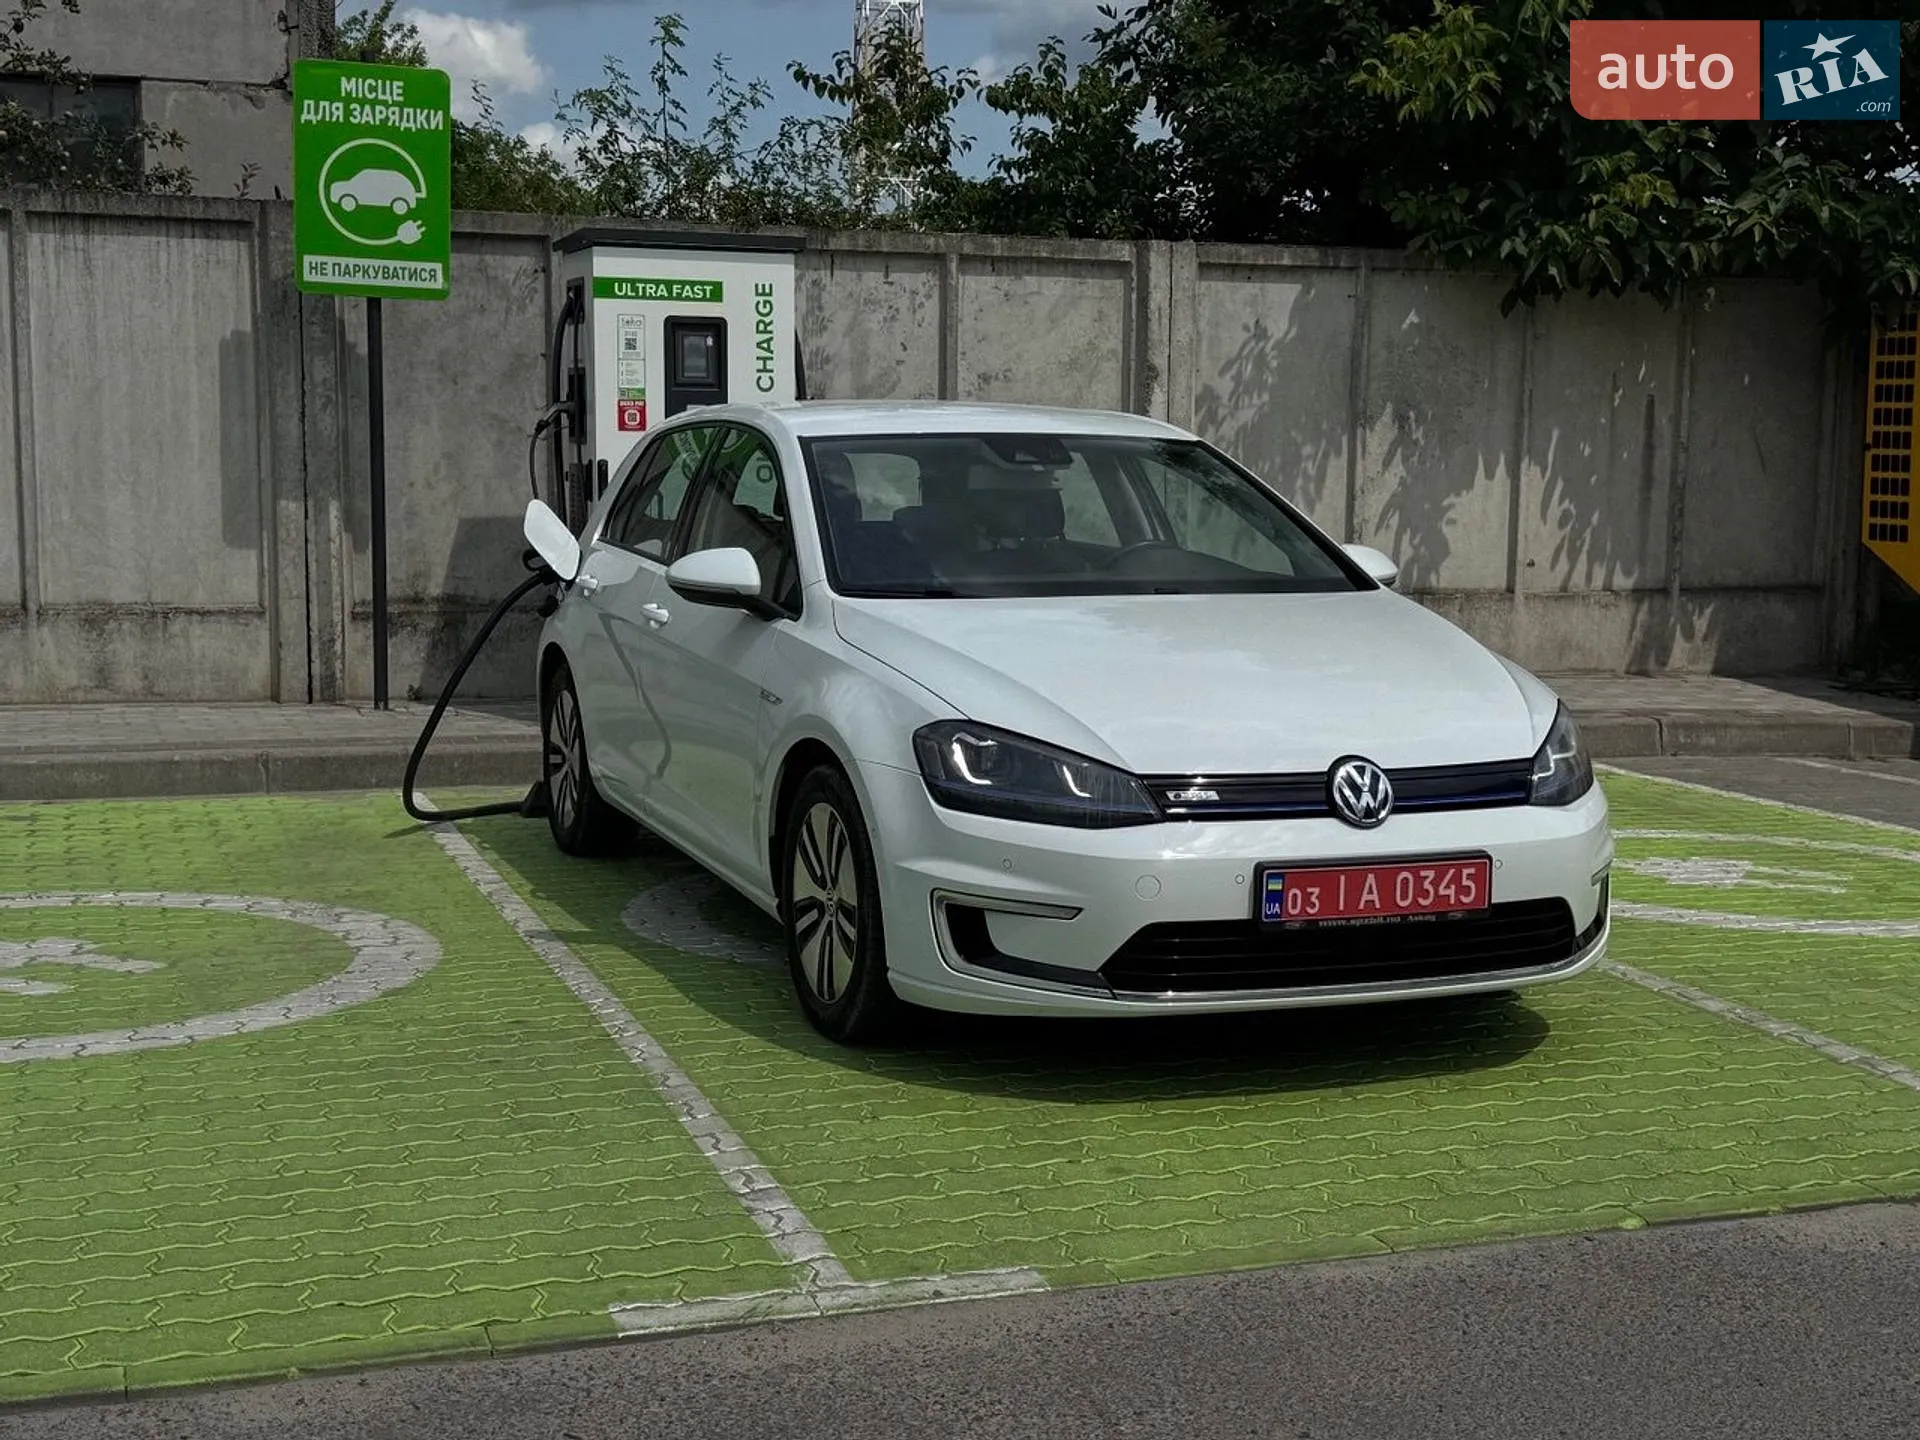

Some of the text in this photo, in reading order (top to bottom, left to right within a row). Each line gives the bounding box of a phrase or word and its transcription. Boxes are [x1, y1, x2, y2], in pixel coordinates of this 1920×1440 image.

[340, 76, 405, 104] МІСЦЕ
[300, 100, 444, 132] ДЛЯ ЗАРЯДКИ
[308, 261, 438, 283] НЕ ПАРКУВАТИСЯ
[614, 281, 713, 299] ULTRA FAST
[754, 282, 774, 393] CHARGE
[1287, 867, 1477, 916] 03 IA 0345
[1265, 902, 1281, 915] UA
